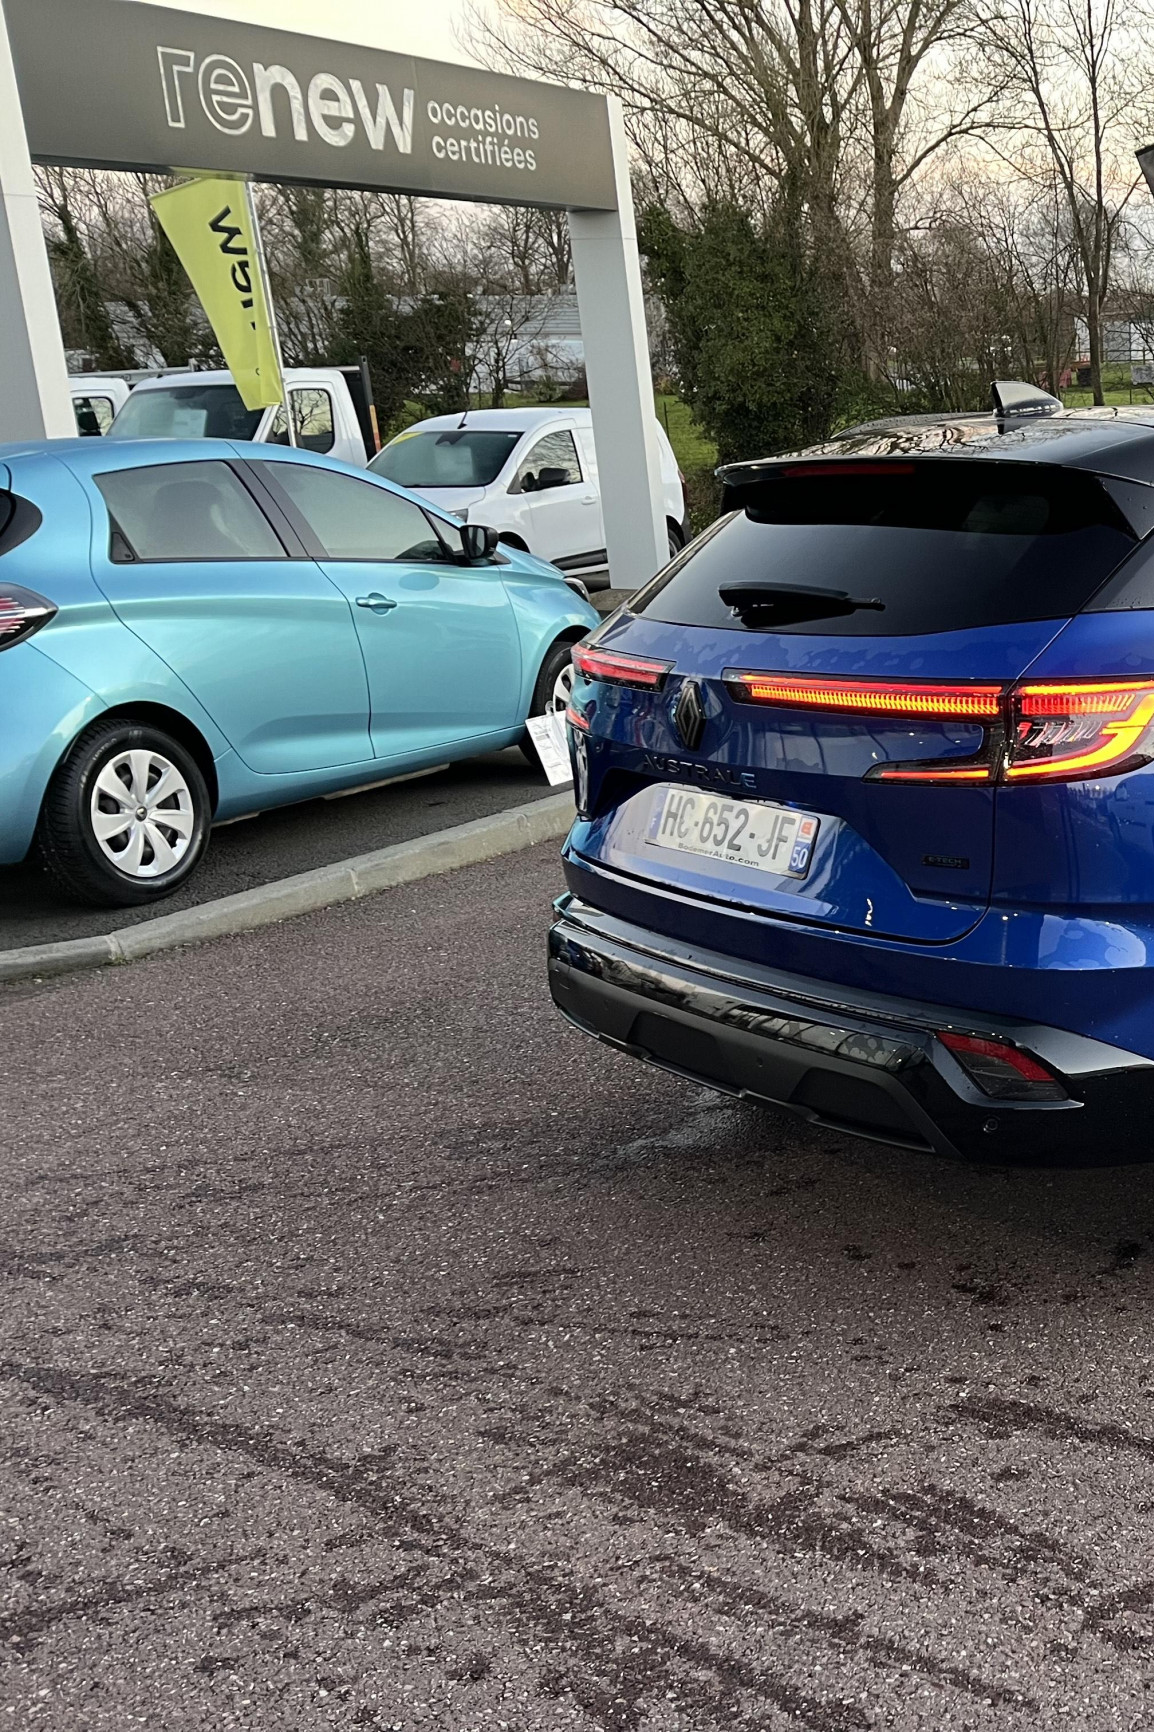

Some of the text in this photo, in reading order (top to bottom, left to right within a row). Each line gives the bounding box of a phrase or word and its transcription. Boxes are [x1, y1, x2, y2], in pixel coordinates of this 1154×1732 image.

[157, 45, 415, 154] renew
[426, 100, 539, 139] occasions
[431, 134, 537, 171] certifiées
[790, 847, 809, 868] 50
